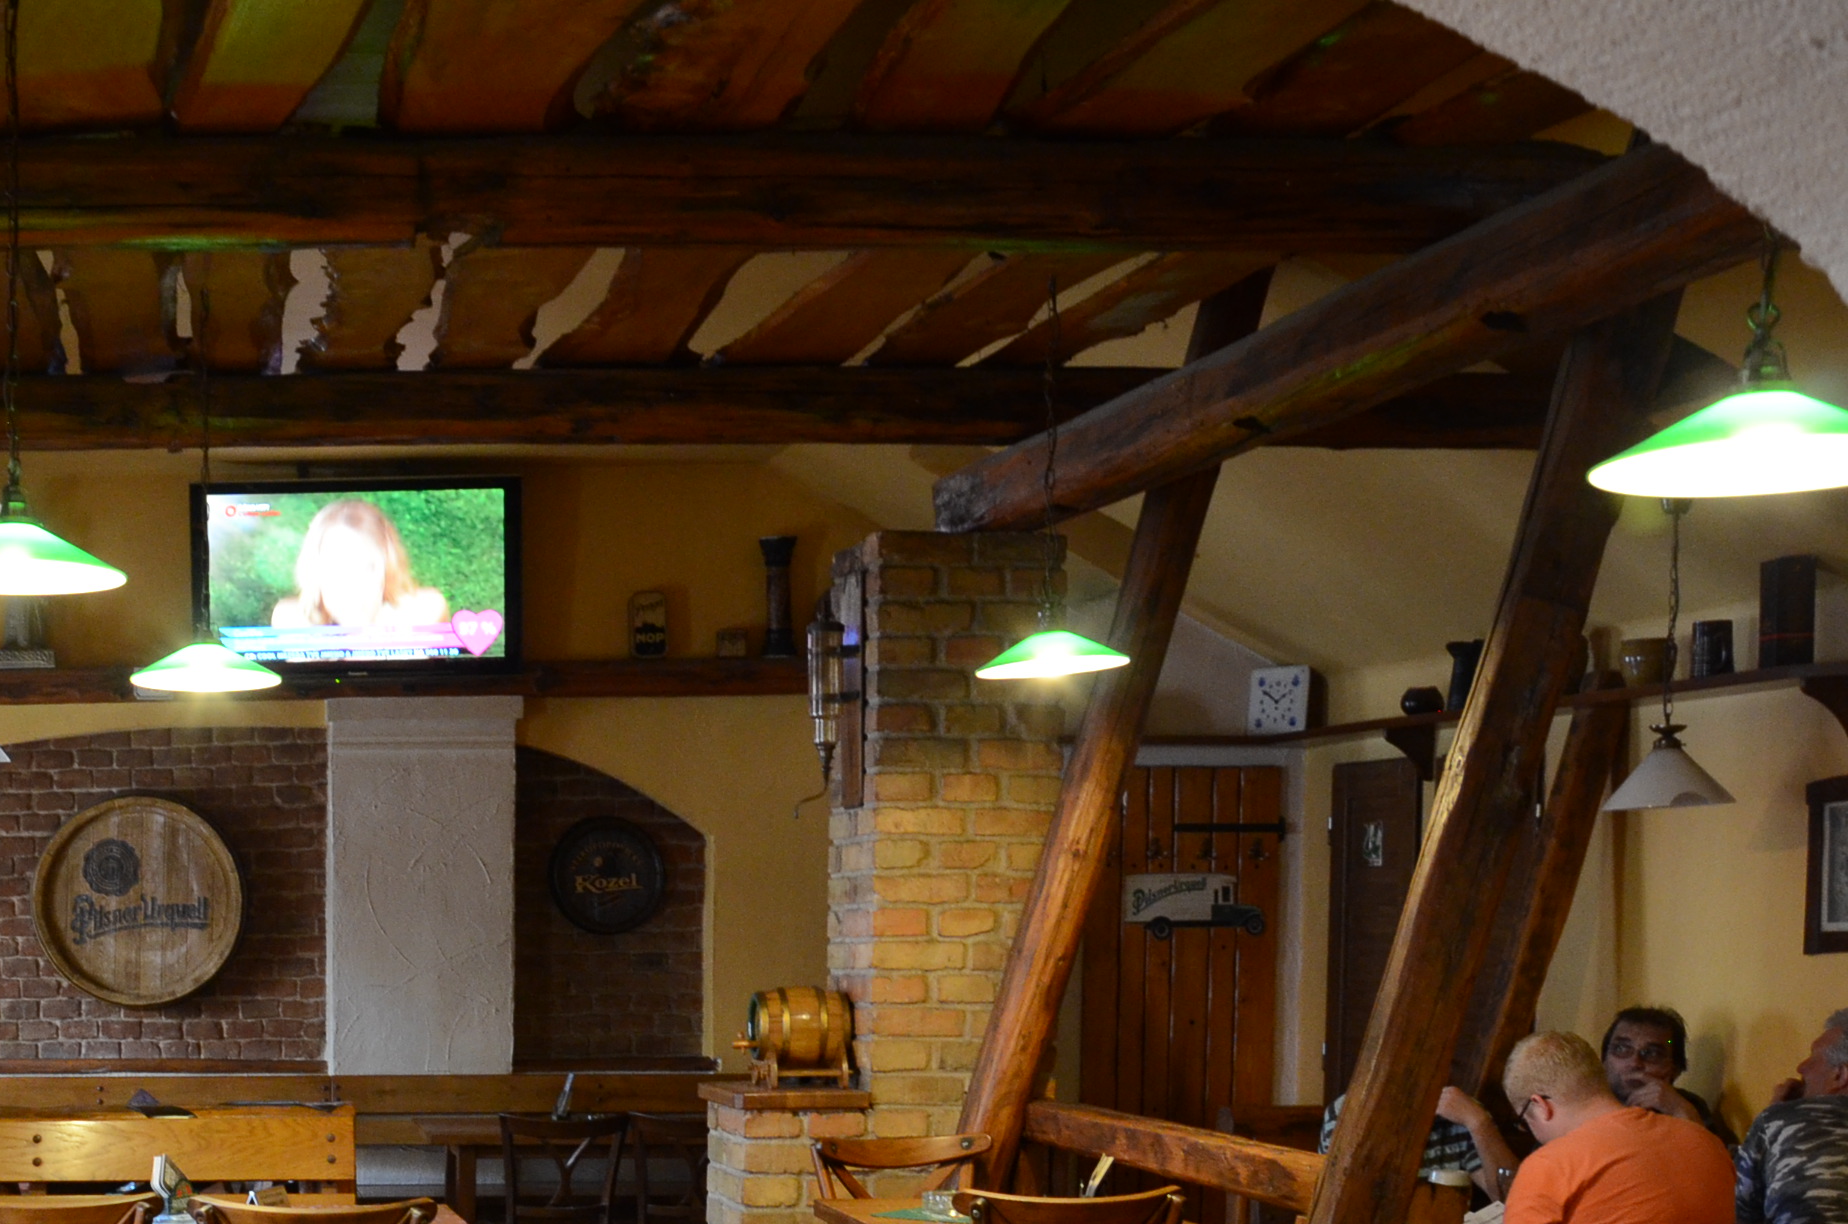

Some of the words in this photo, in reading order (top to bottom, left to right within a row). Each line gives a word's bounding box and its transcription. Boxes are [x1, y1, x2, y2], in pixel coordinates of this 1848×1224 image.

[574, 872, 643, 894] Kozel
[71, 893, 142, 946] Pilsner
[141, 892, 210, 932] Urquell
